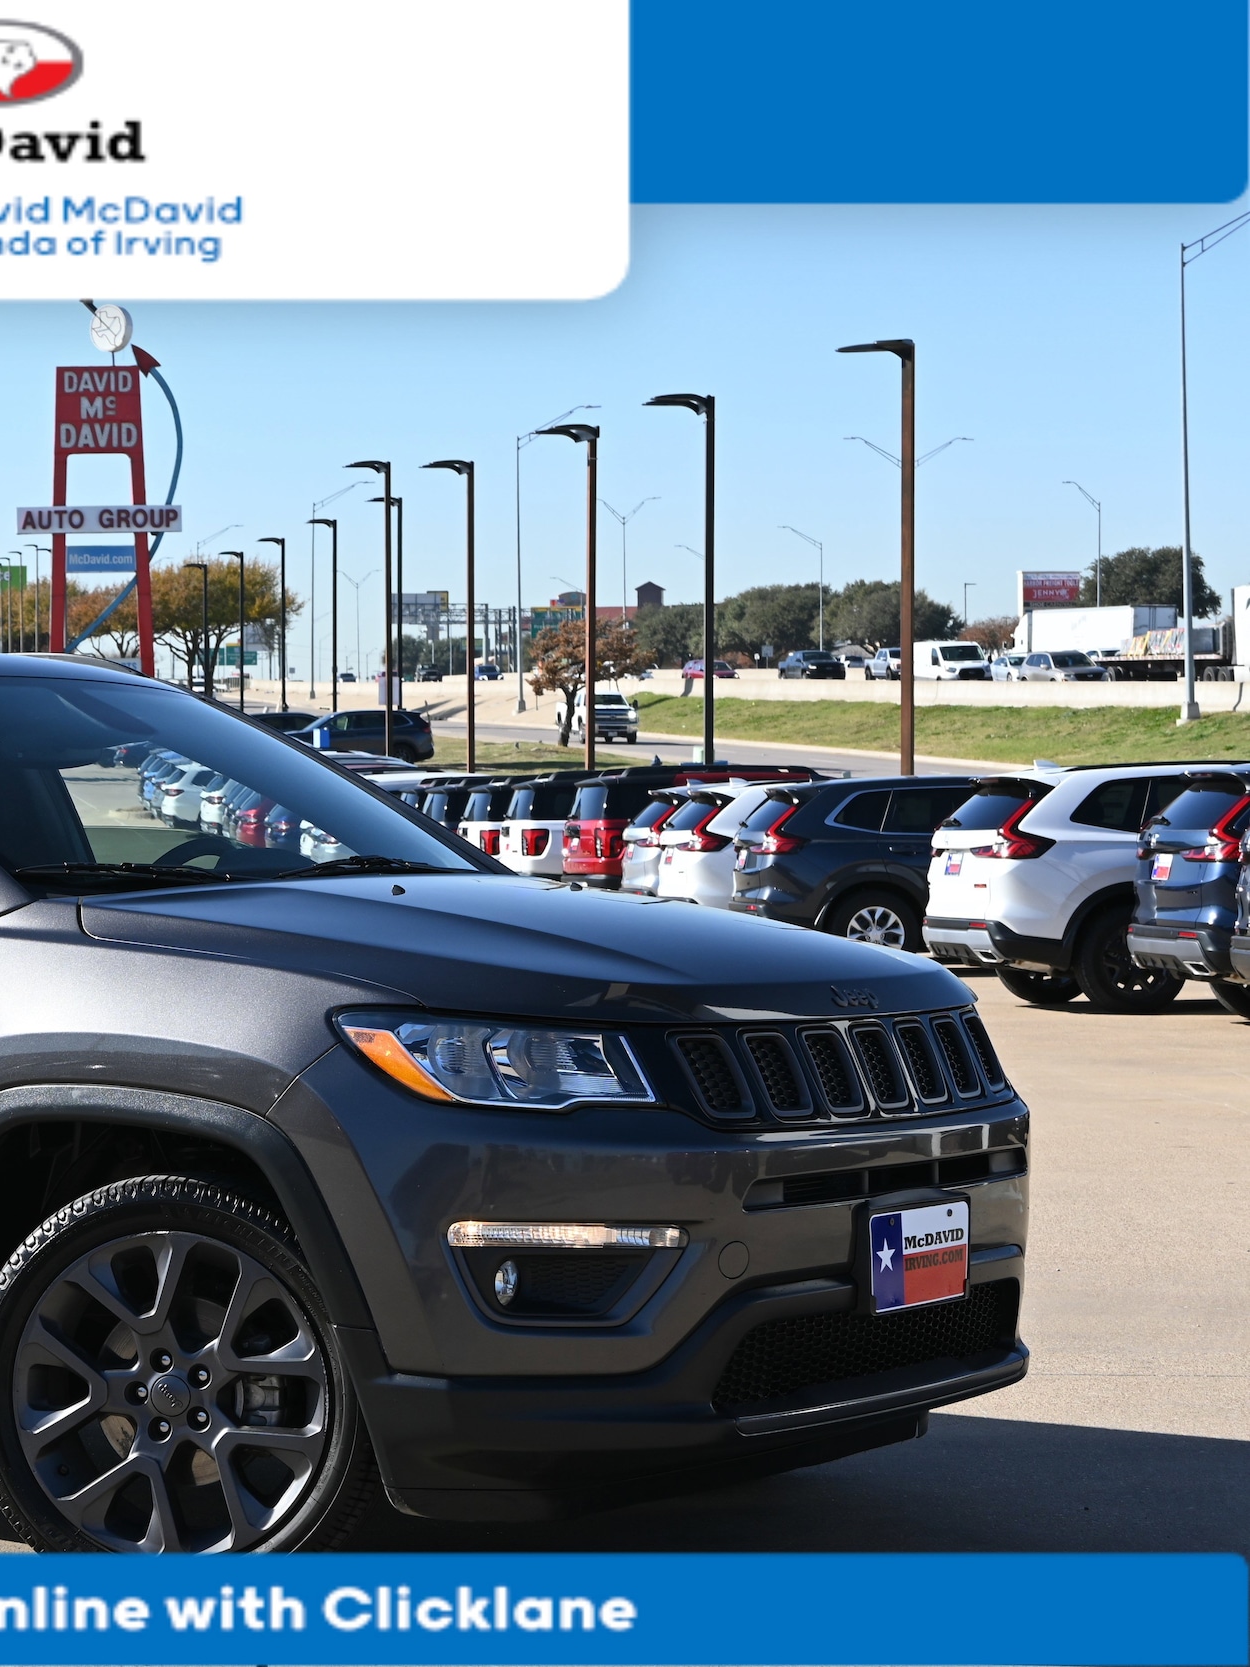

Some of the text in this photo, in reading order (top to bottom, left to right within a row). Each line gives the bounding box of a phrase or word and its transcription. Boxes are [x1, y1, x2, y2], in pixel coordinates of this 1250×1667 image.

[63, 370, 132, 393] DAVID
[60, 422, 138, 449] DAVID
[22, 508, 179, 530] AUTO GROUP
[68, 553, 133, 566] McDavid.com
[831, 985, 878, 1009] Jeep
[904, 1228, 965, 1250] McDAVID
[905, 1248, 964, 1271] IRVING.COM
